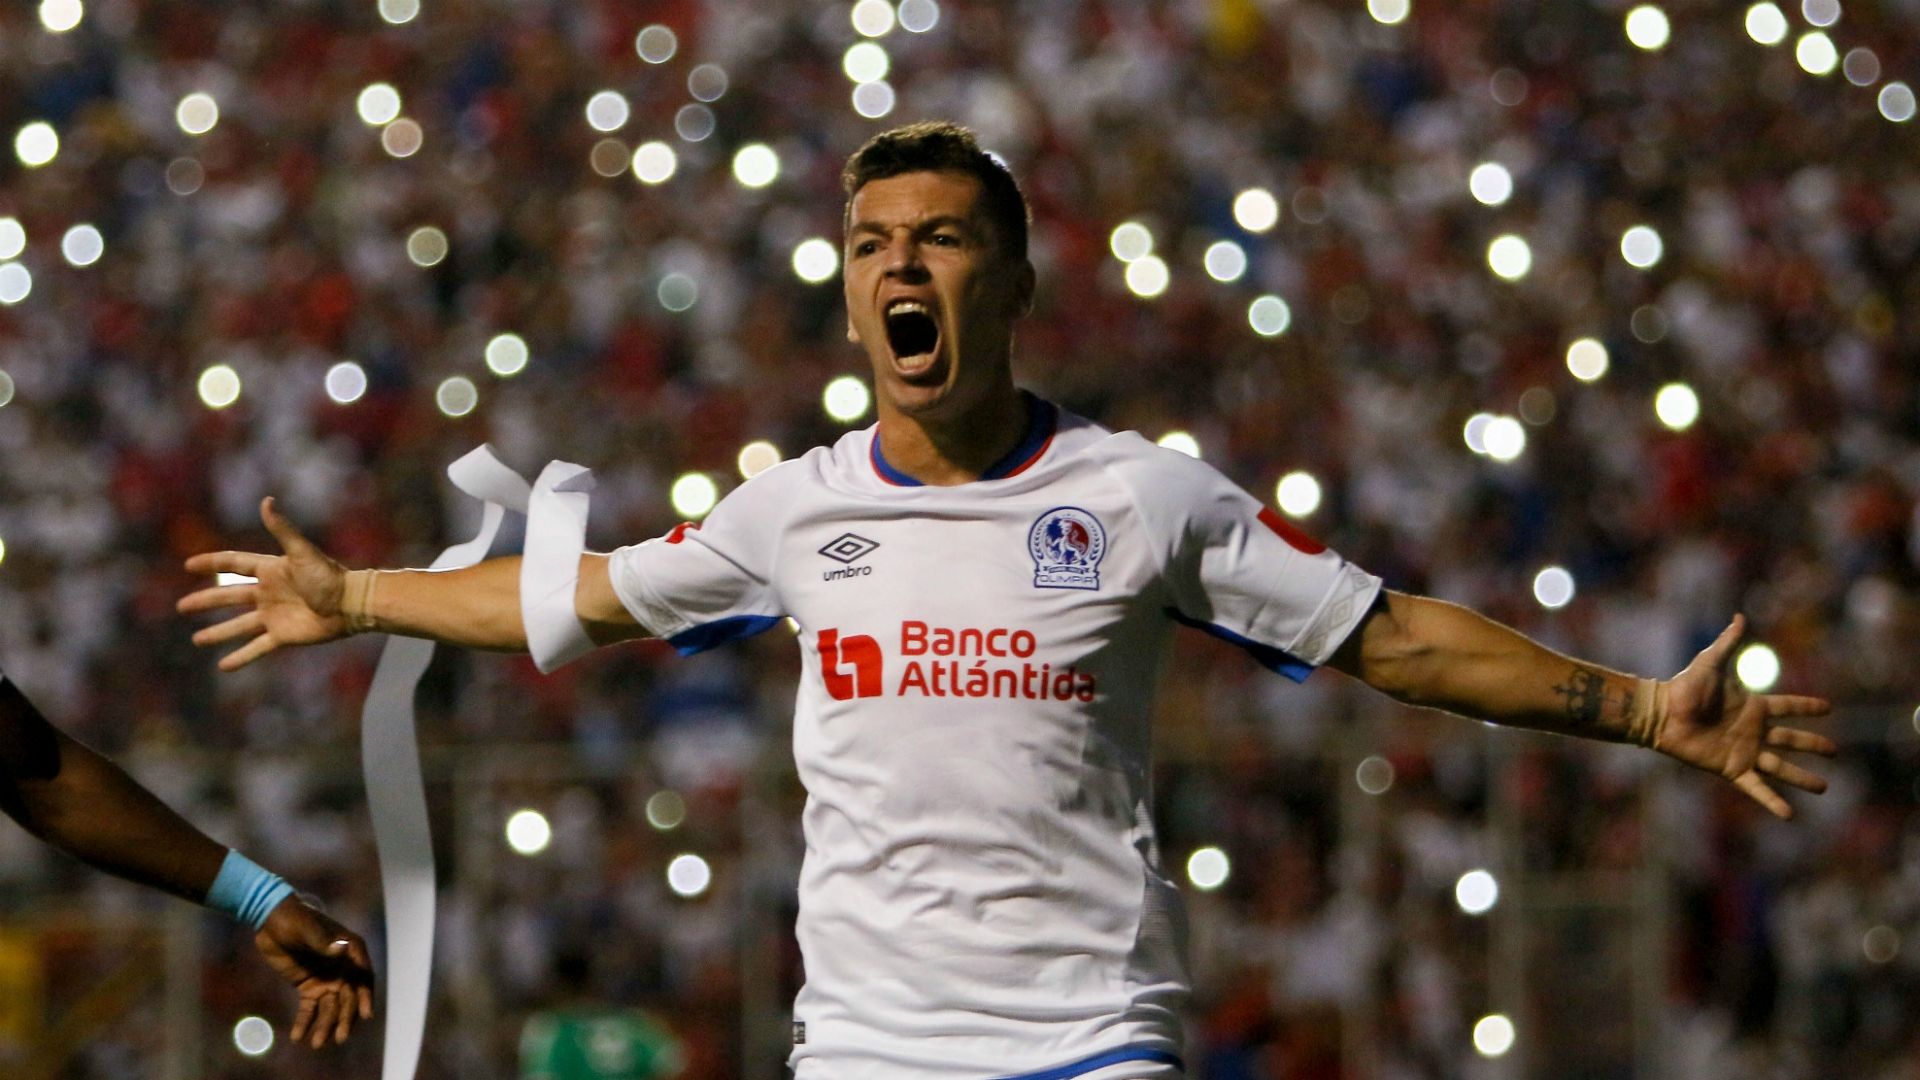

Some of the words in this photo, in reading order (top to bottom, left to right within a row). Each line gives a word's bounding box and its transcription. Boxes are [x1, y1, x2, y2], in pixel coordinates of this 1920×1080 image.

[823, 565, 872, 582] umbro
[1039, 574, 1094, 585] OLIMPIA
[901, 620, 1037, 658] Banco
[897, 660, 1096, 702] Atlántida
